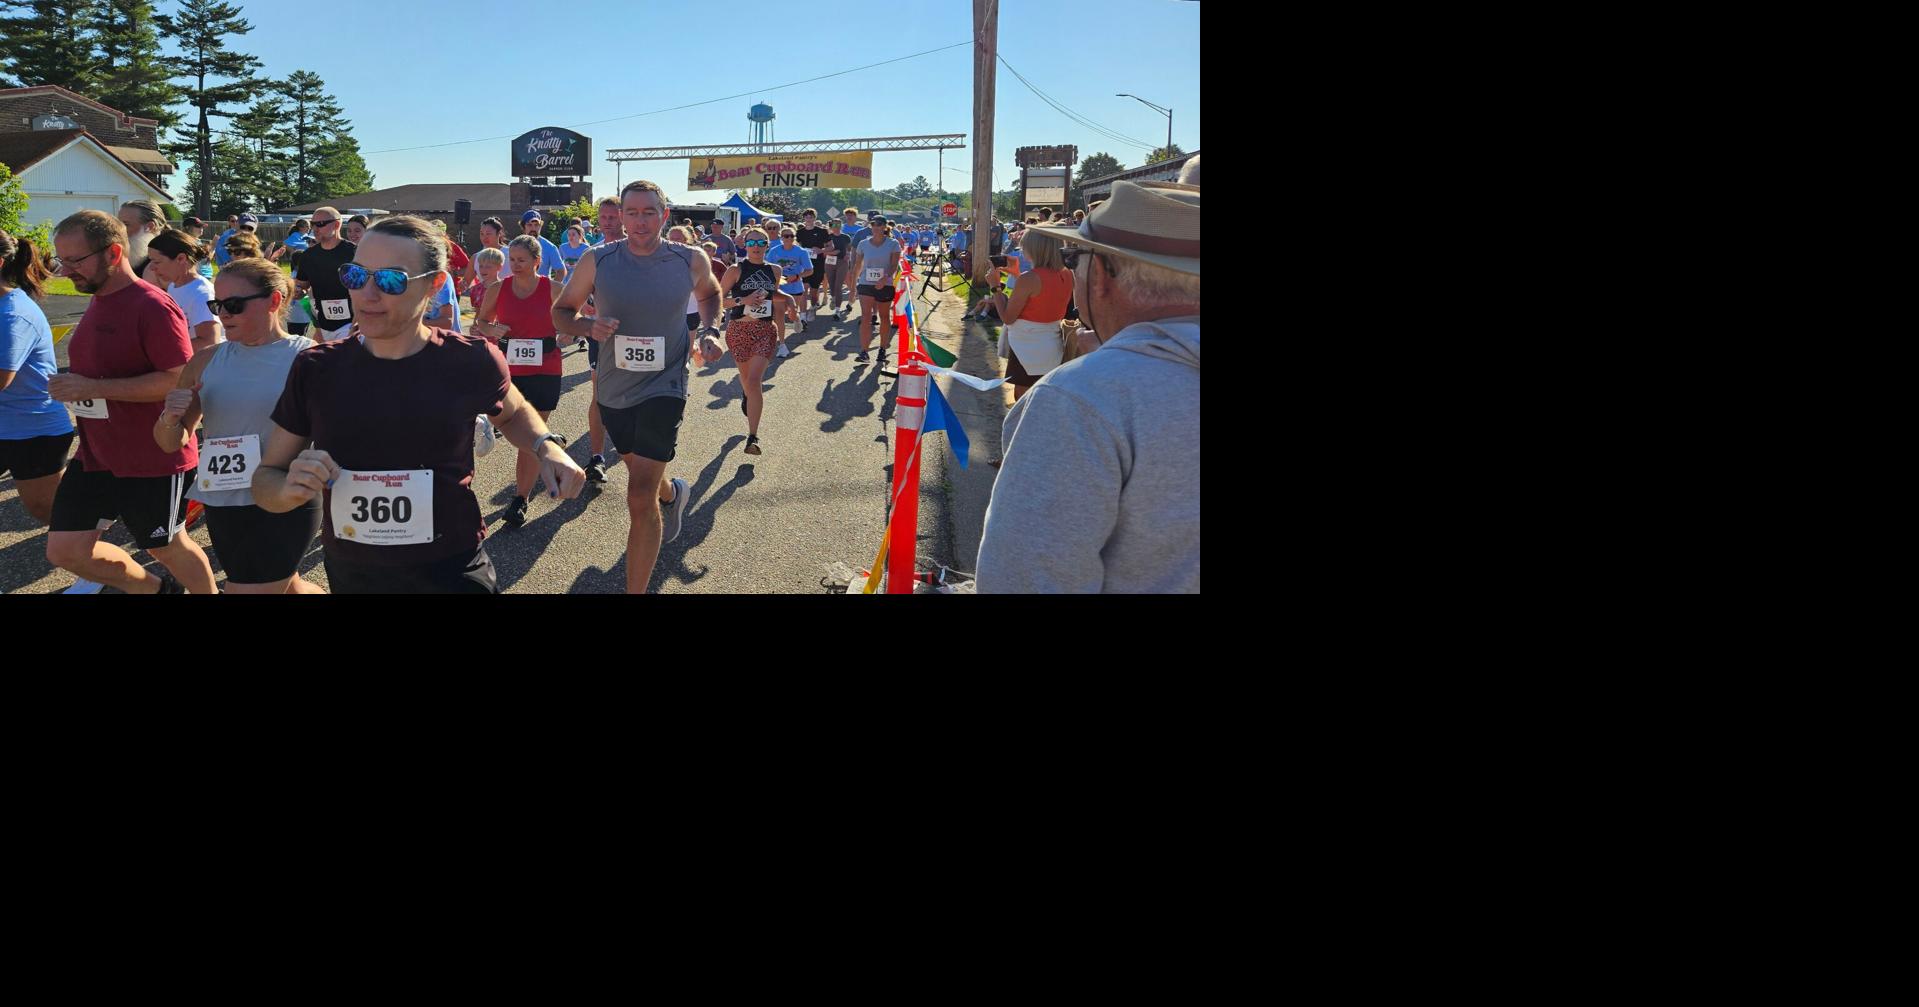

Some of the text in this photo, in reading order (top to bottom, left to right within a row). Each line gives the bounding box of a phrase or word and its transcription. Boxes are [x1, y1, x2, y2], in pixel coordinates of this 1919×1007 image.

[540, 129, 553, 138] The
[527, 136, 562, 154] Knotty
[535, 153, 575, 170] Barrel
[717, 160, 872, 181] Bear Cupboard Run
[762, 173, 819, 187] FINISH
[328, 306, 344, 315] 190
[514, 347, 536, 358] 195
[625, 347, 656, 362] 358
[208, 453, 246, 475] 423
[352, 473, 410, 483] Bear Cupboard
[351, 495, 412, 523] 360
